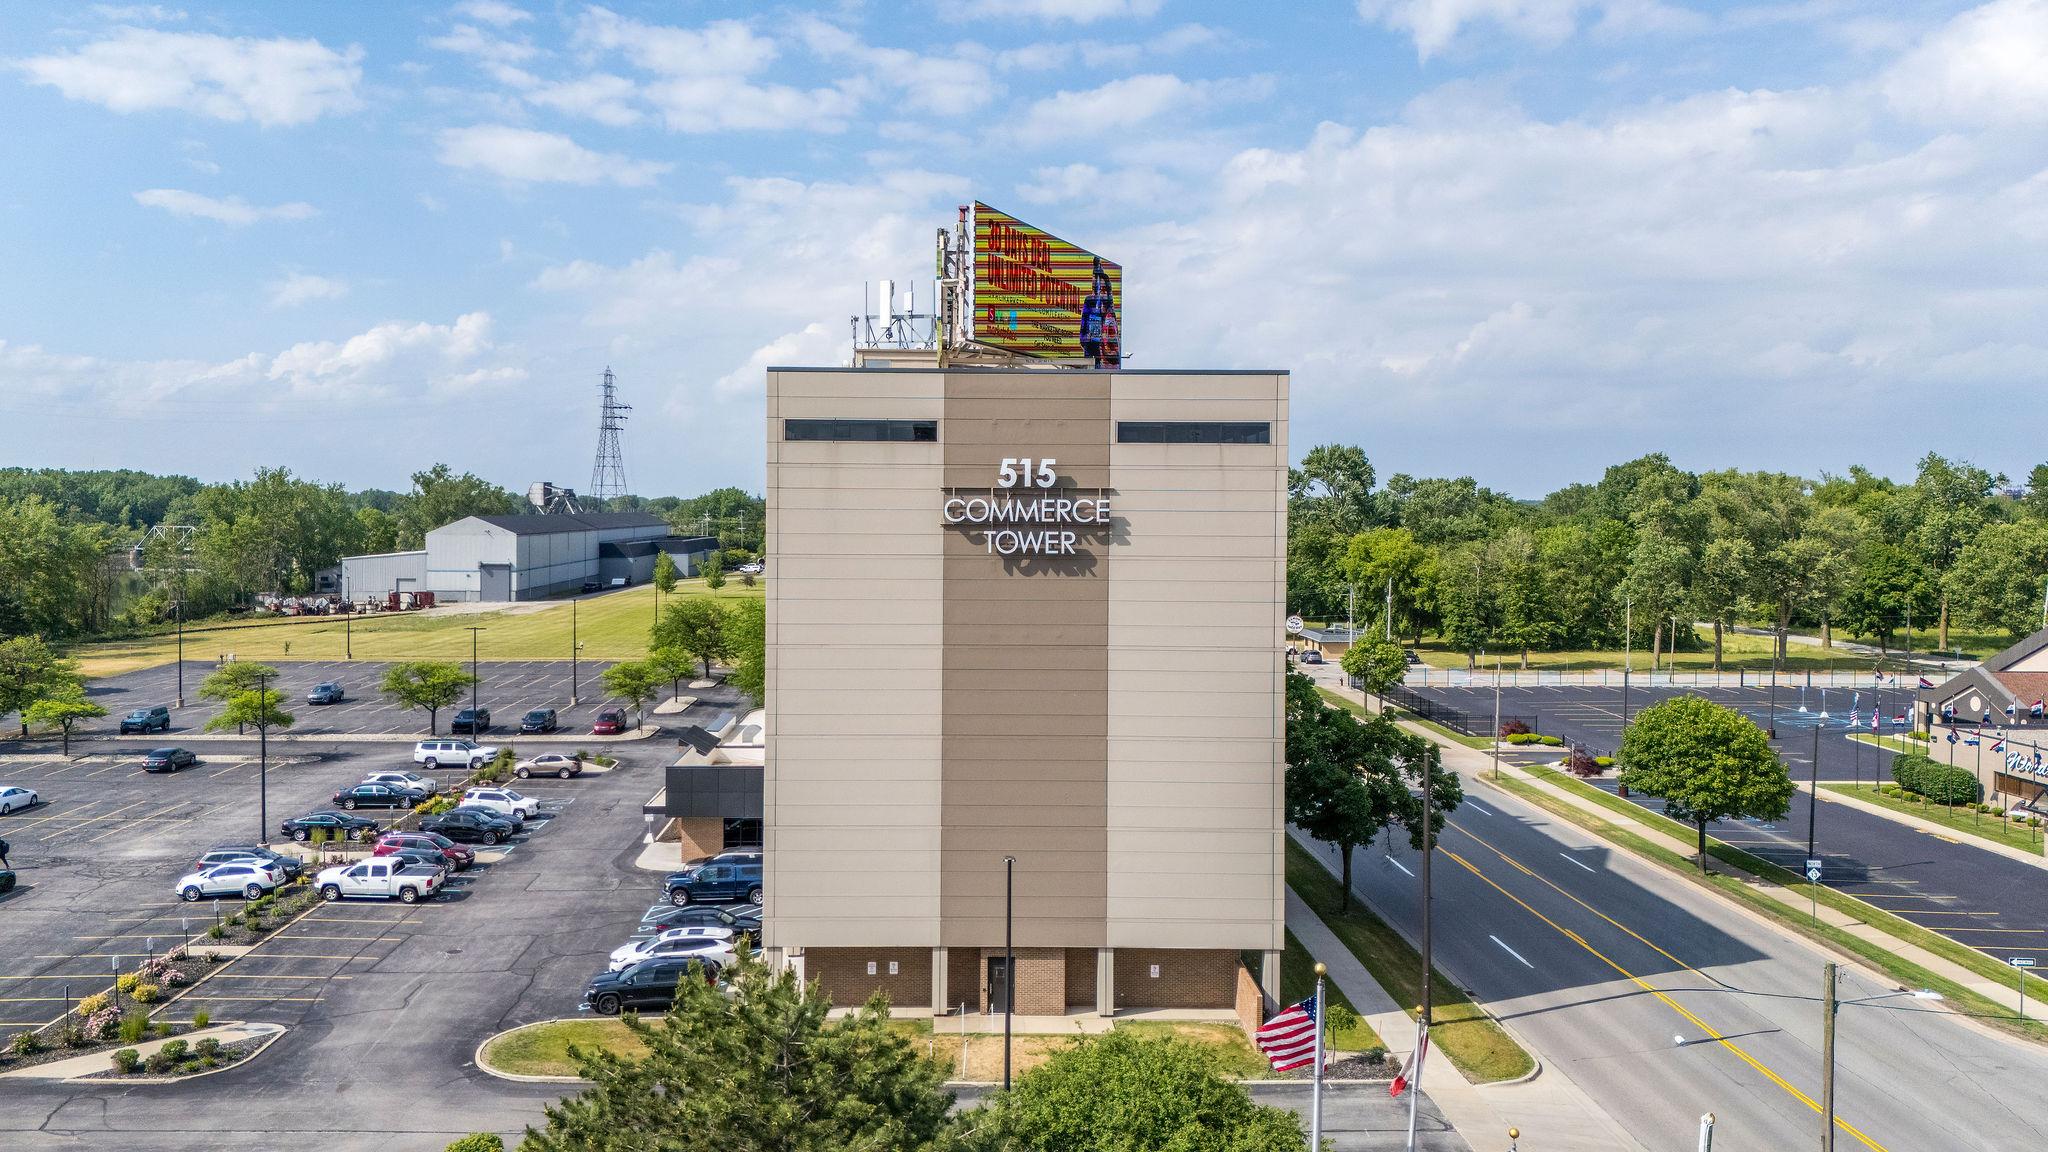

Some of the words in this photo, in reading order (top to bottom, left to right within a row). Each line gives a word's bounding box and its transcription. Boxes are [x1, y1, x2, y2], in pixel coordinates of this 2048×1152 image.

[1005, 225, 1028, 264] DAYS
[988, 252, 1037, 300] UNLIMITED
[1040, 273, 1081, 315] POTENTIAL
[997, 458, 1056, 488] 515
[944, 498, 1110, 523] COMMERCE
[984, 530, 1076, 555] TOWER
